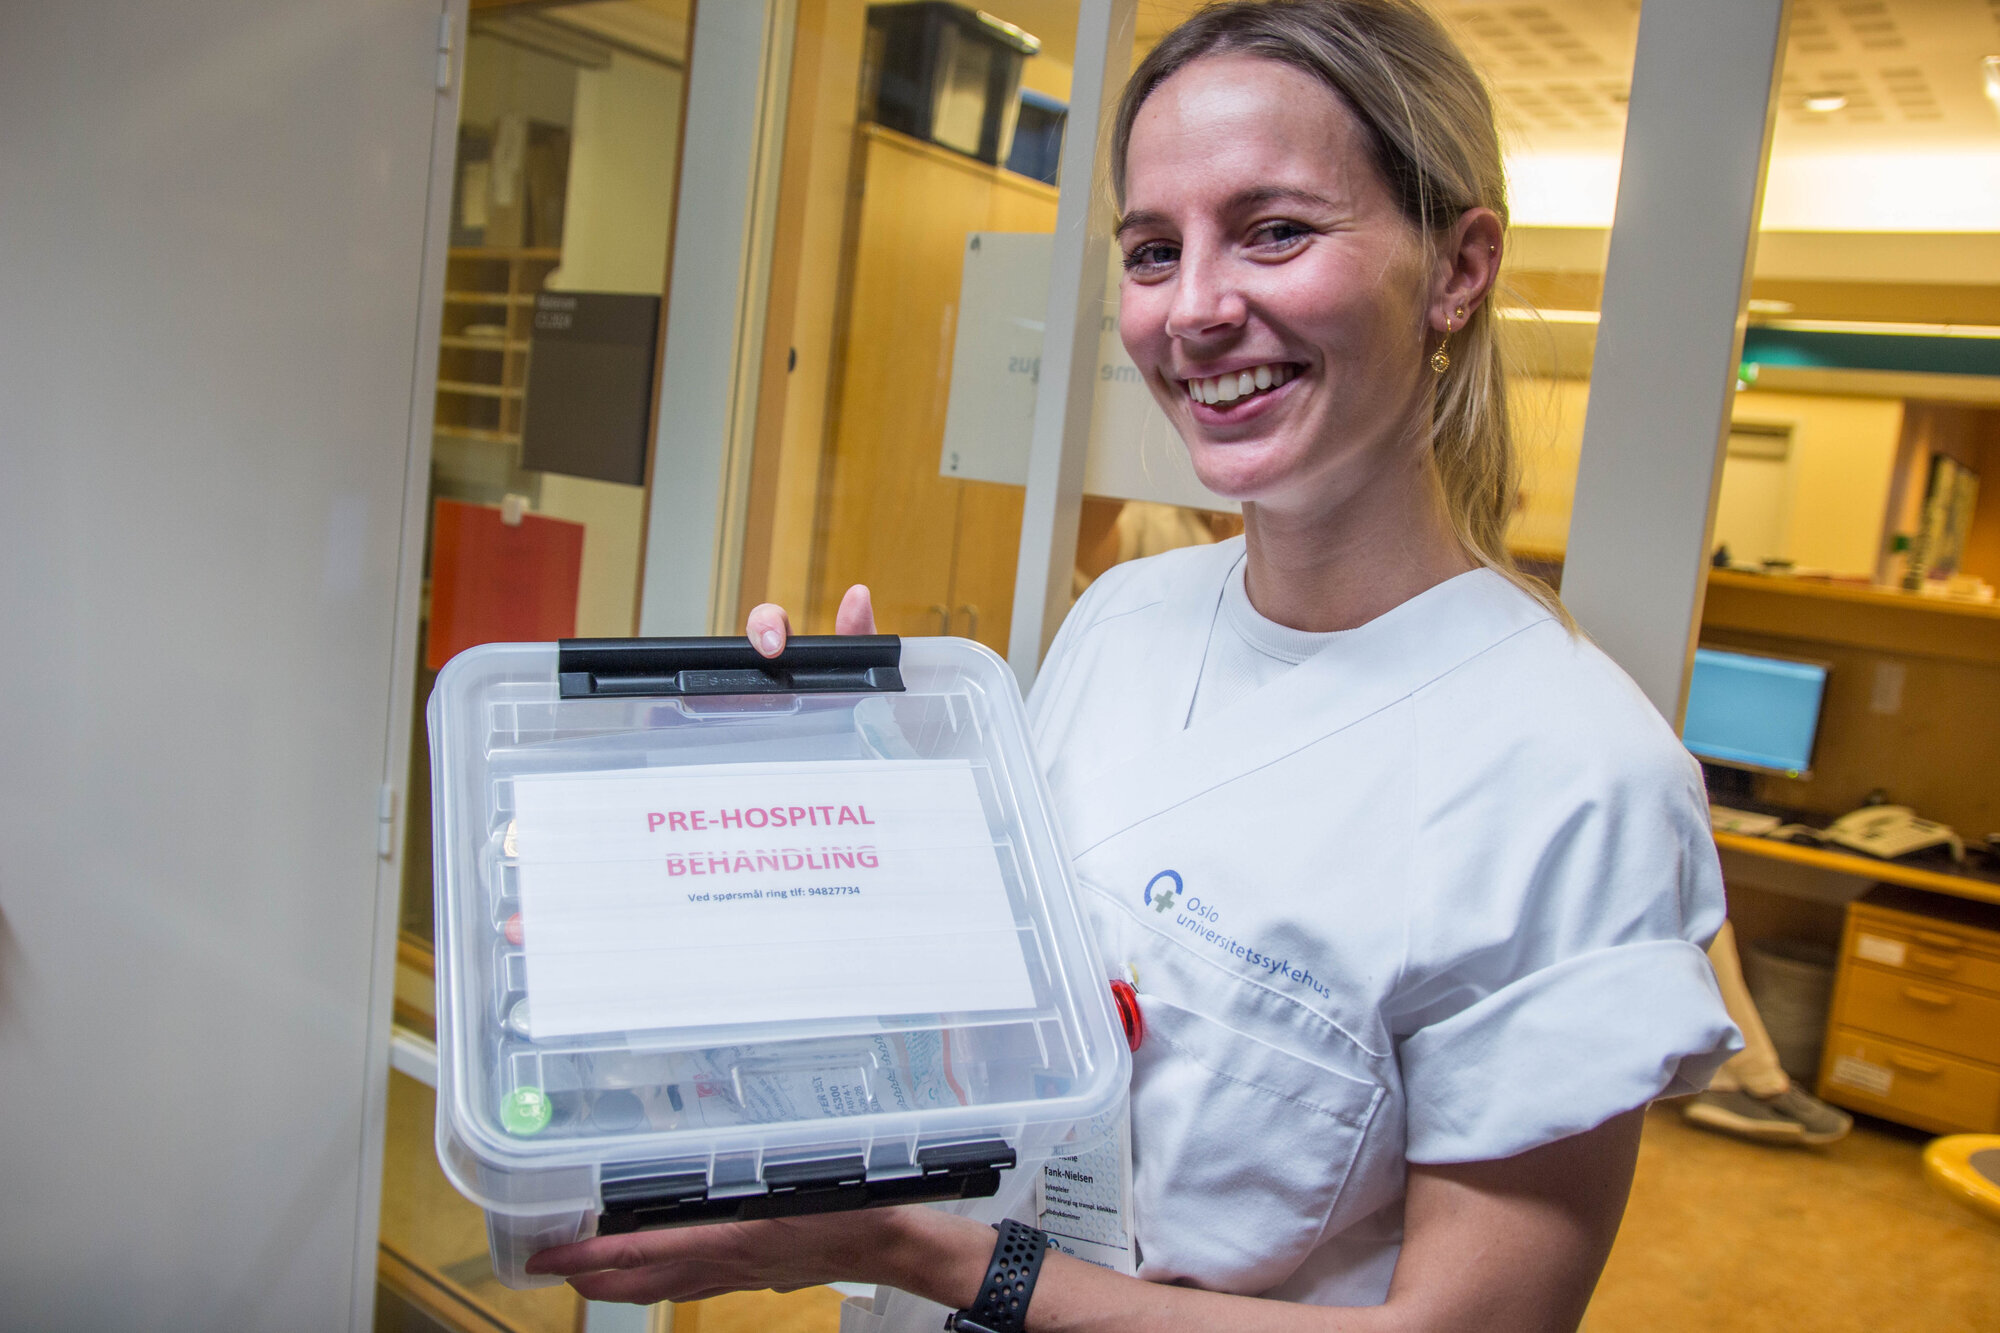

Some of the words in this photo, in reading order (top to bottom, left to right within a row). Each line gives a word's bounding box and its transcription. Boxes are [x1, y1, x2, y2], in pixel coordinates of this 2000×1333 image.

[647, 805, 875, 833] PRE-HOSPITAL
[666, 845, 880, 877] BEHANDLING
[688, 892, 710, 902] Ved
[713, 888, 763, 902] spørsmål
[766, 887, 788, 899] ring
[790, 887, 806, 897] tlf:
[808, 886, 861, 897] 94827734
[1186, 897, 1220, 923] Oslo
[1176, 913, 1331, 999] universitetssykehus
